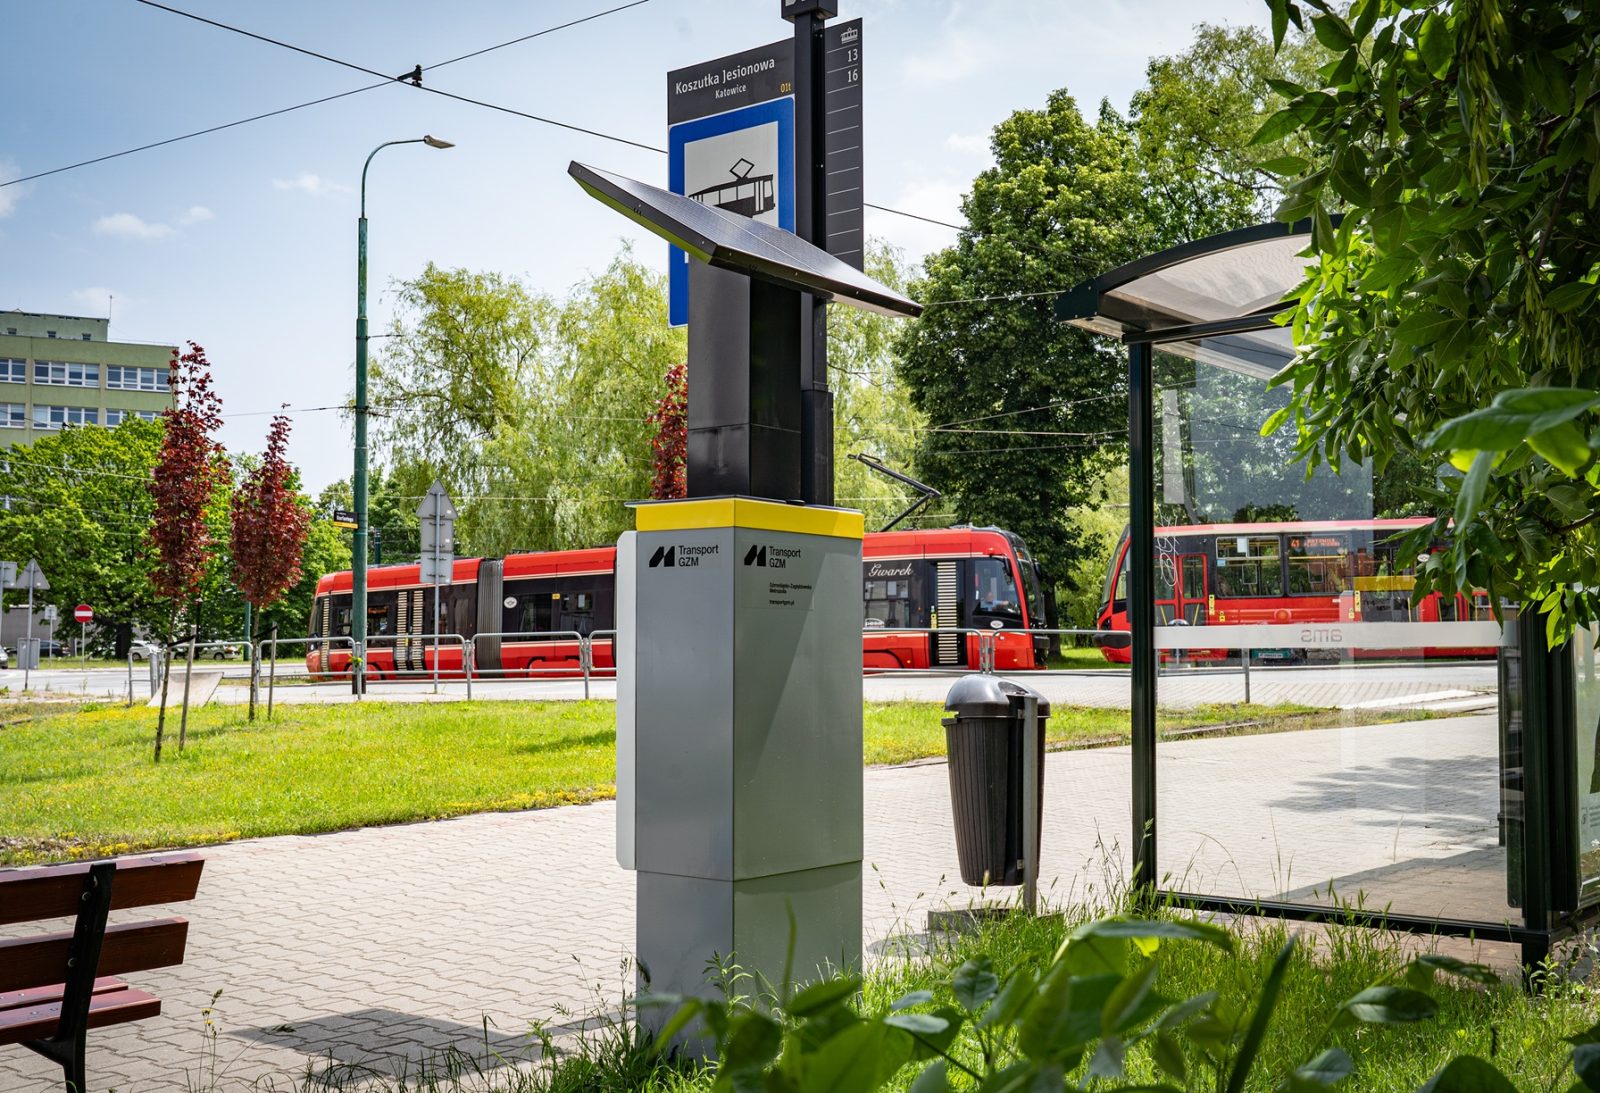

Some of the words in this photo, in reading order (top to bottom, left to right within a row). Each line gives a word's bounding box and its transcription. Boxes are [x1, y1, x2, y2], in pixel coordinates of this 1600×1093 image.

[847, 48, 859, 63] 13
[675, 73, 720, 95] Koszutka
[722, 58, 775, 84] Jesionowa
[847, 68, 859, 83] 16
[715, 84, 747, 99] Katowice
[678, 544, 719, 556] Transport
[769, 546, 802, 558] Transport
[678, 556, 699, 567] GZM
[769, 557, 786, 568] GZM
[868, 562, 914, 577] Gwarek
